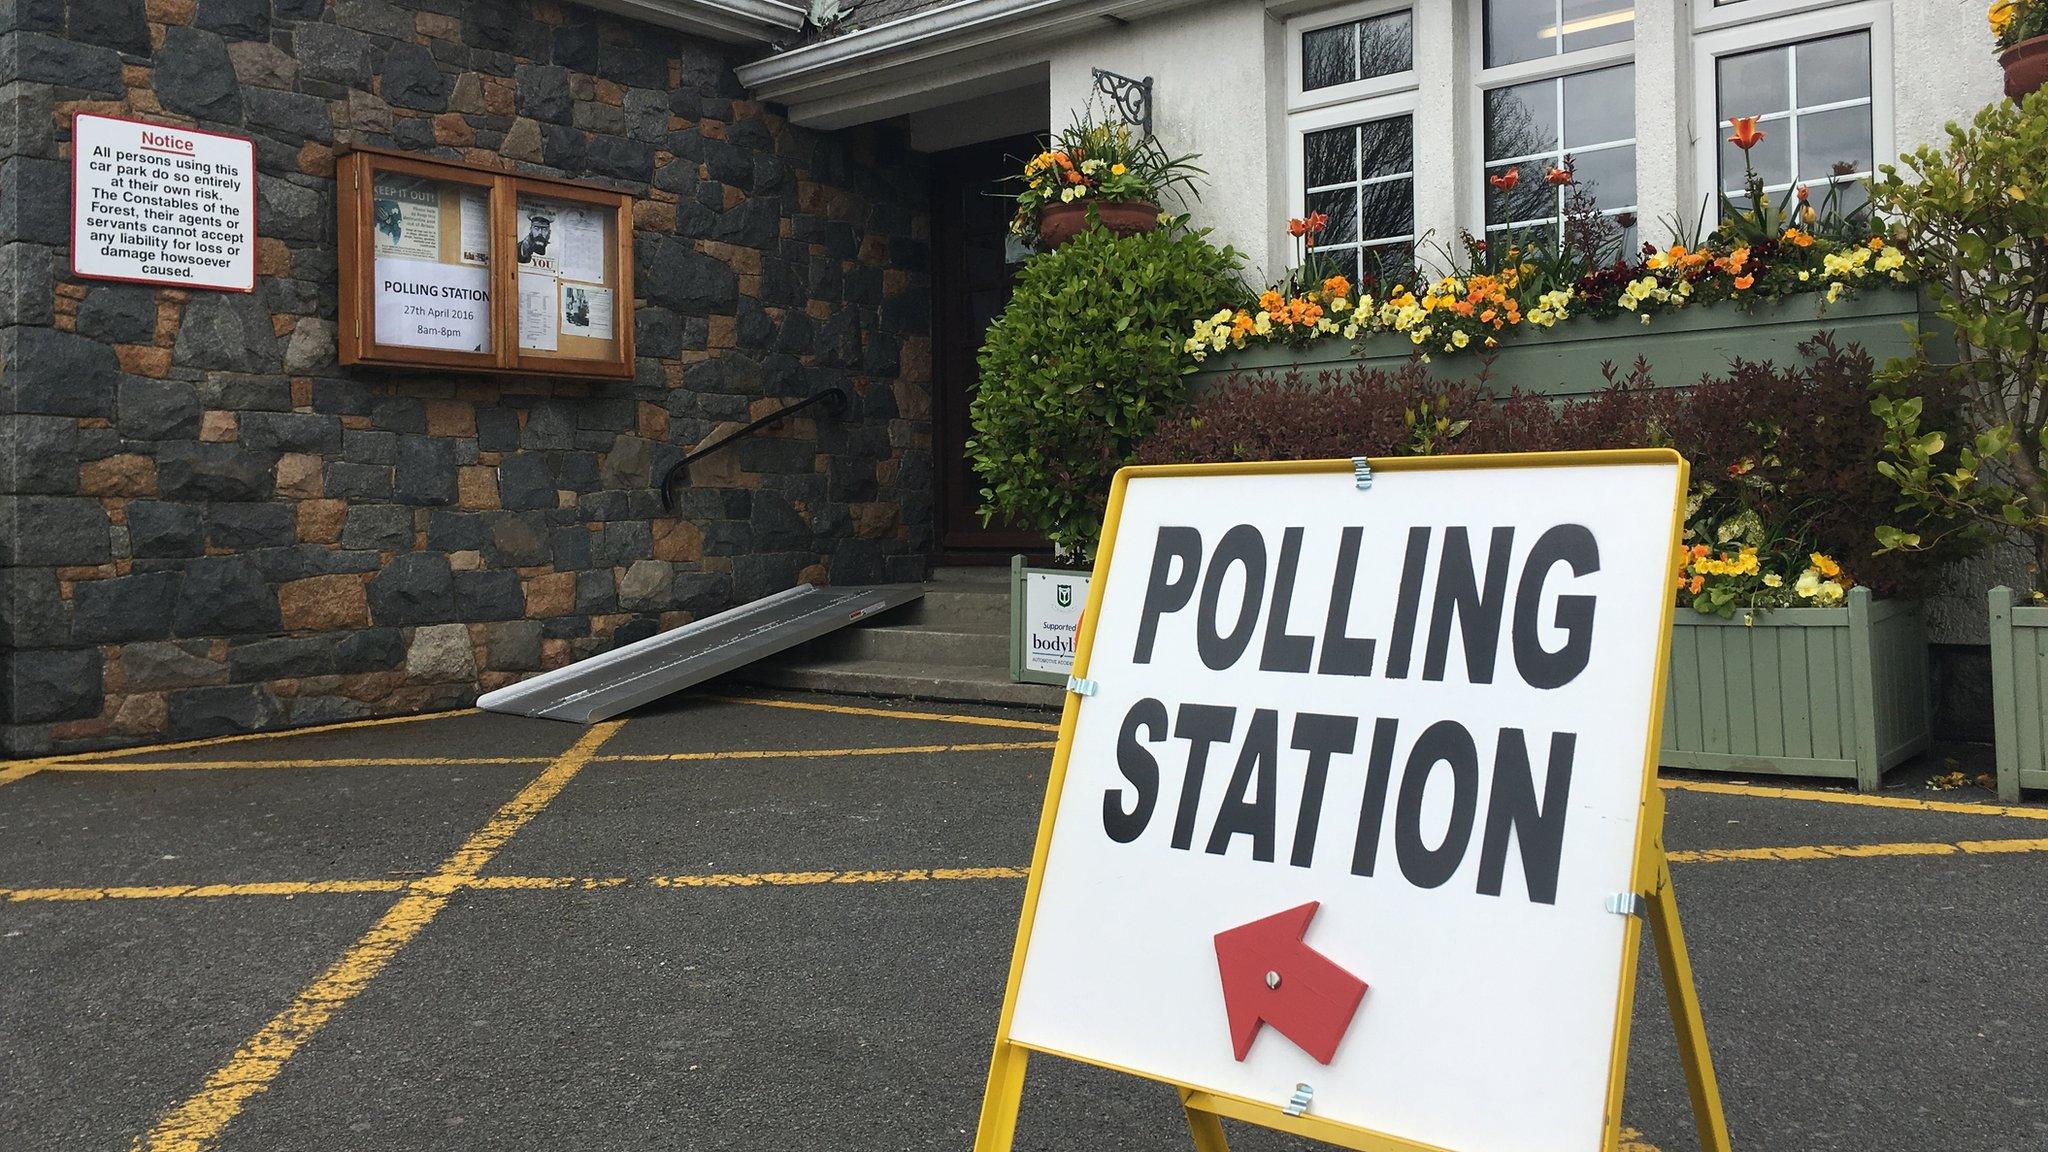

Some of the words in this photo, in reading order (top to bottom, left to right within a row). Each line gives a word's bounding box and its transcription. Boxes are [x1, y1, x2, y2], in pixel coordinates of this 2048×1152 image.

[142, 131, 193, 151] Notice
[93, 146, 110, 158] All
[116, 149, 171, 166] persons
[177, 160, 210, 175] using
[215, 164, 238, 176] this
[90, 160, 111, 172] car
[117, 165, 146, 177] park
[152, 168, 169, 180] do
[174, 173, 189, 183] so
[195, 174, 240, 191] entirely
[111, 177, 124, 187] at
[129, 178, 158, 192] their
[164, 185, 190, 196] own
[196, 188, 222, 201] risk.
[399, 189, 407, 197] IT
[410, 191, 434, 202] OUT!
[92, 188, 117, 201] The
[123, 190, 198, 211] Constables
[204, 202, 215, 213] of
[221, 204, 239, 216] the
[92, 202, 138, 219] Forest,
[145, 208, 174, 221] their
[179, 213, 222, 228] agents
[227, 219, 239, 229] or
[87, 217, 146, 232] servants
[152, 224, 196, 238] cannot
[202, 228, 243, 244] accept
[90, 232, 114, 244] any
[120, 233, 168, 250] liability
[174, 239, 191, 250] for
[196, 241, 222, 254] loss
[228, 246, 240, 256] or
[101, 246, 155, 262] damage
[161, 251, 230, 268] howsoever
[532, 259, 553, 269] YOU
[142, 264, 193, 278] caused.
[385, 280, 438, 297] POLLING
[442, 287, 490, 302] STATION
[404, 306, 425, 317] 27th
[428, 307, 449, 320] April
[452, 309, 473, 320] 2016
[417, 325, 461, 338] 8am-8pm
[1133, 524, 1600, 690] POLLING
[1043, 622, 1076, 631] Supported
[1103, 698, 1577, 905] STATION
